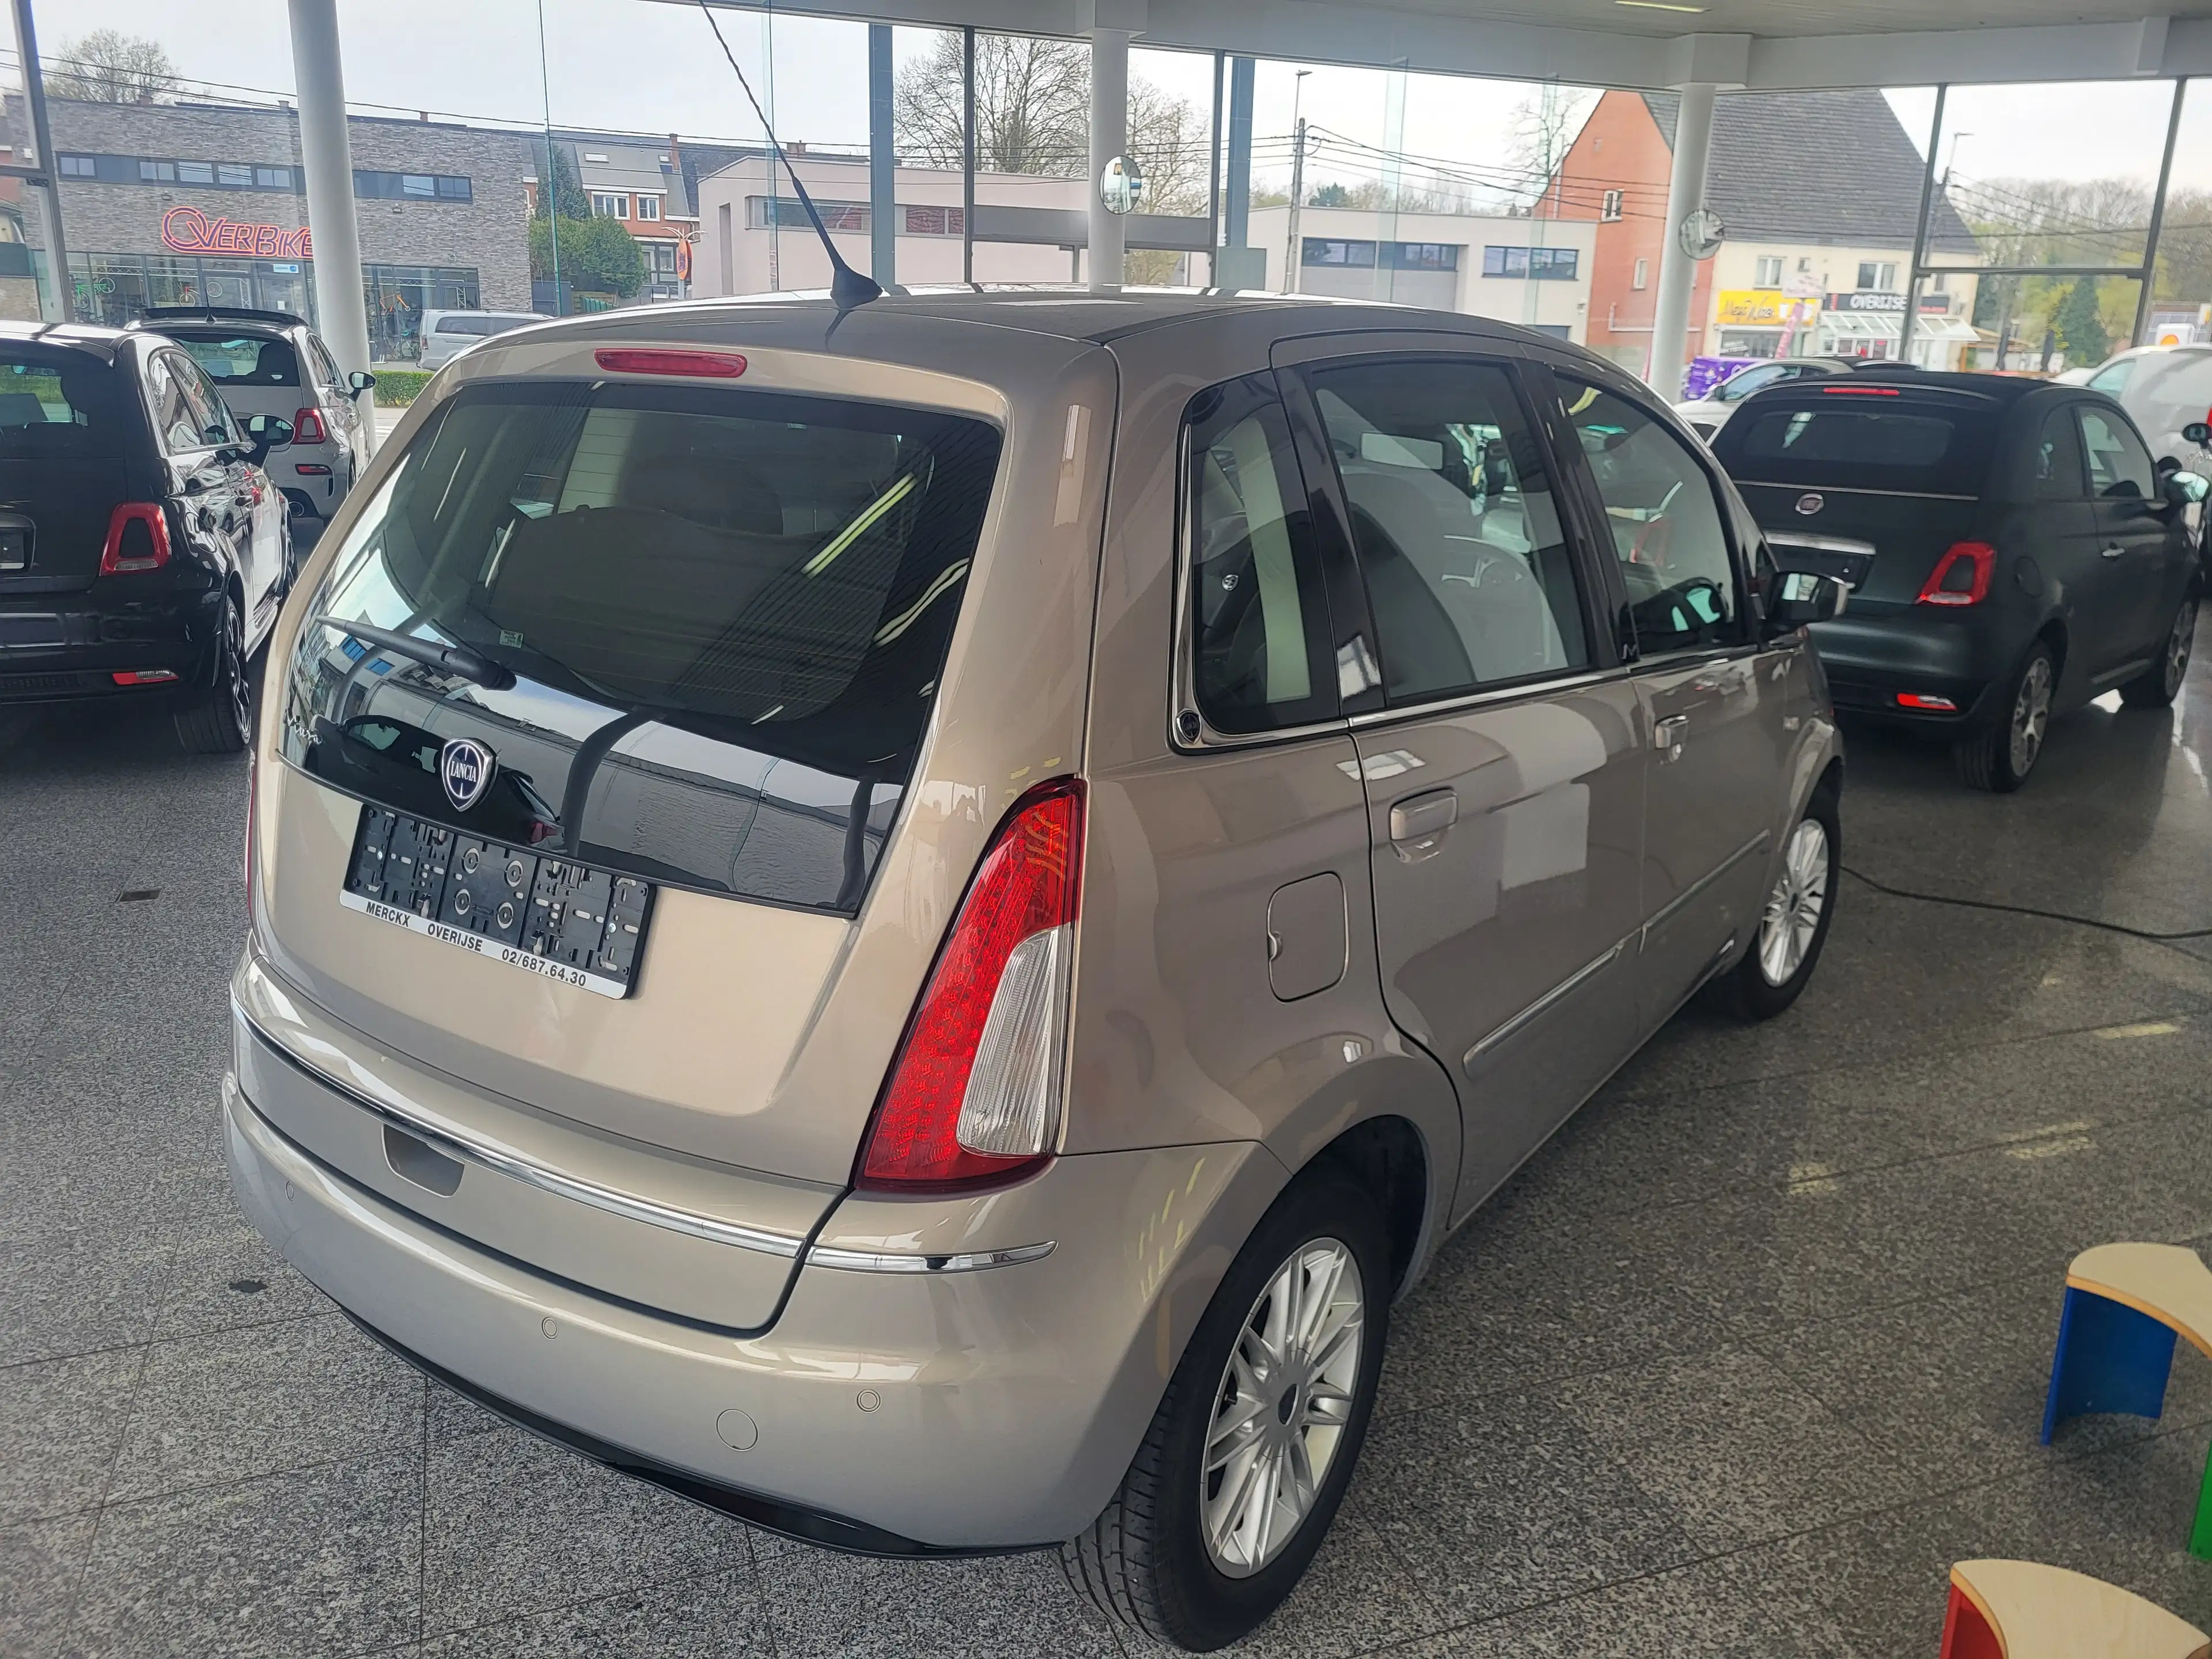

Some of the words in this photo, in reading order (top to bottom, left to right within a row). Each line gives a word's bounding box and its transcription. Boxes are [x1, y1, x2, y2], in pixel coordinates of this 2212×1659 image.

[450, 761, 477, 782] LANCIA
[366, 901, 411, 927] MERCKX
[427, 923, 483, 952] OVERIJSE
[502, 949, 586, 986] 02/687.64.30
